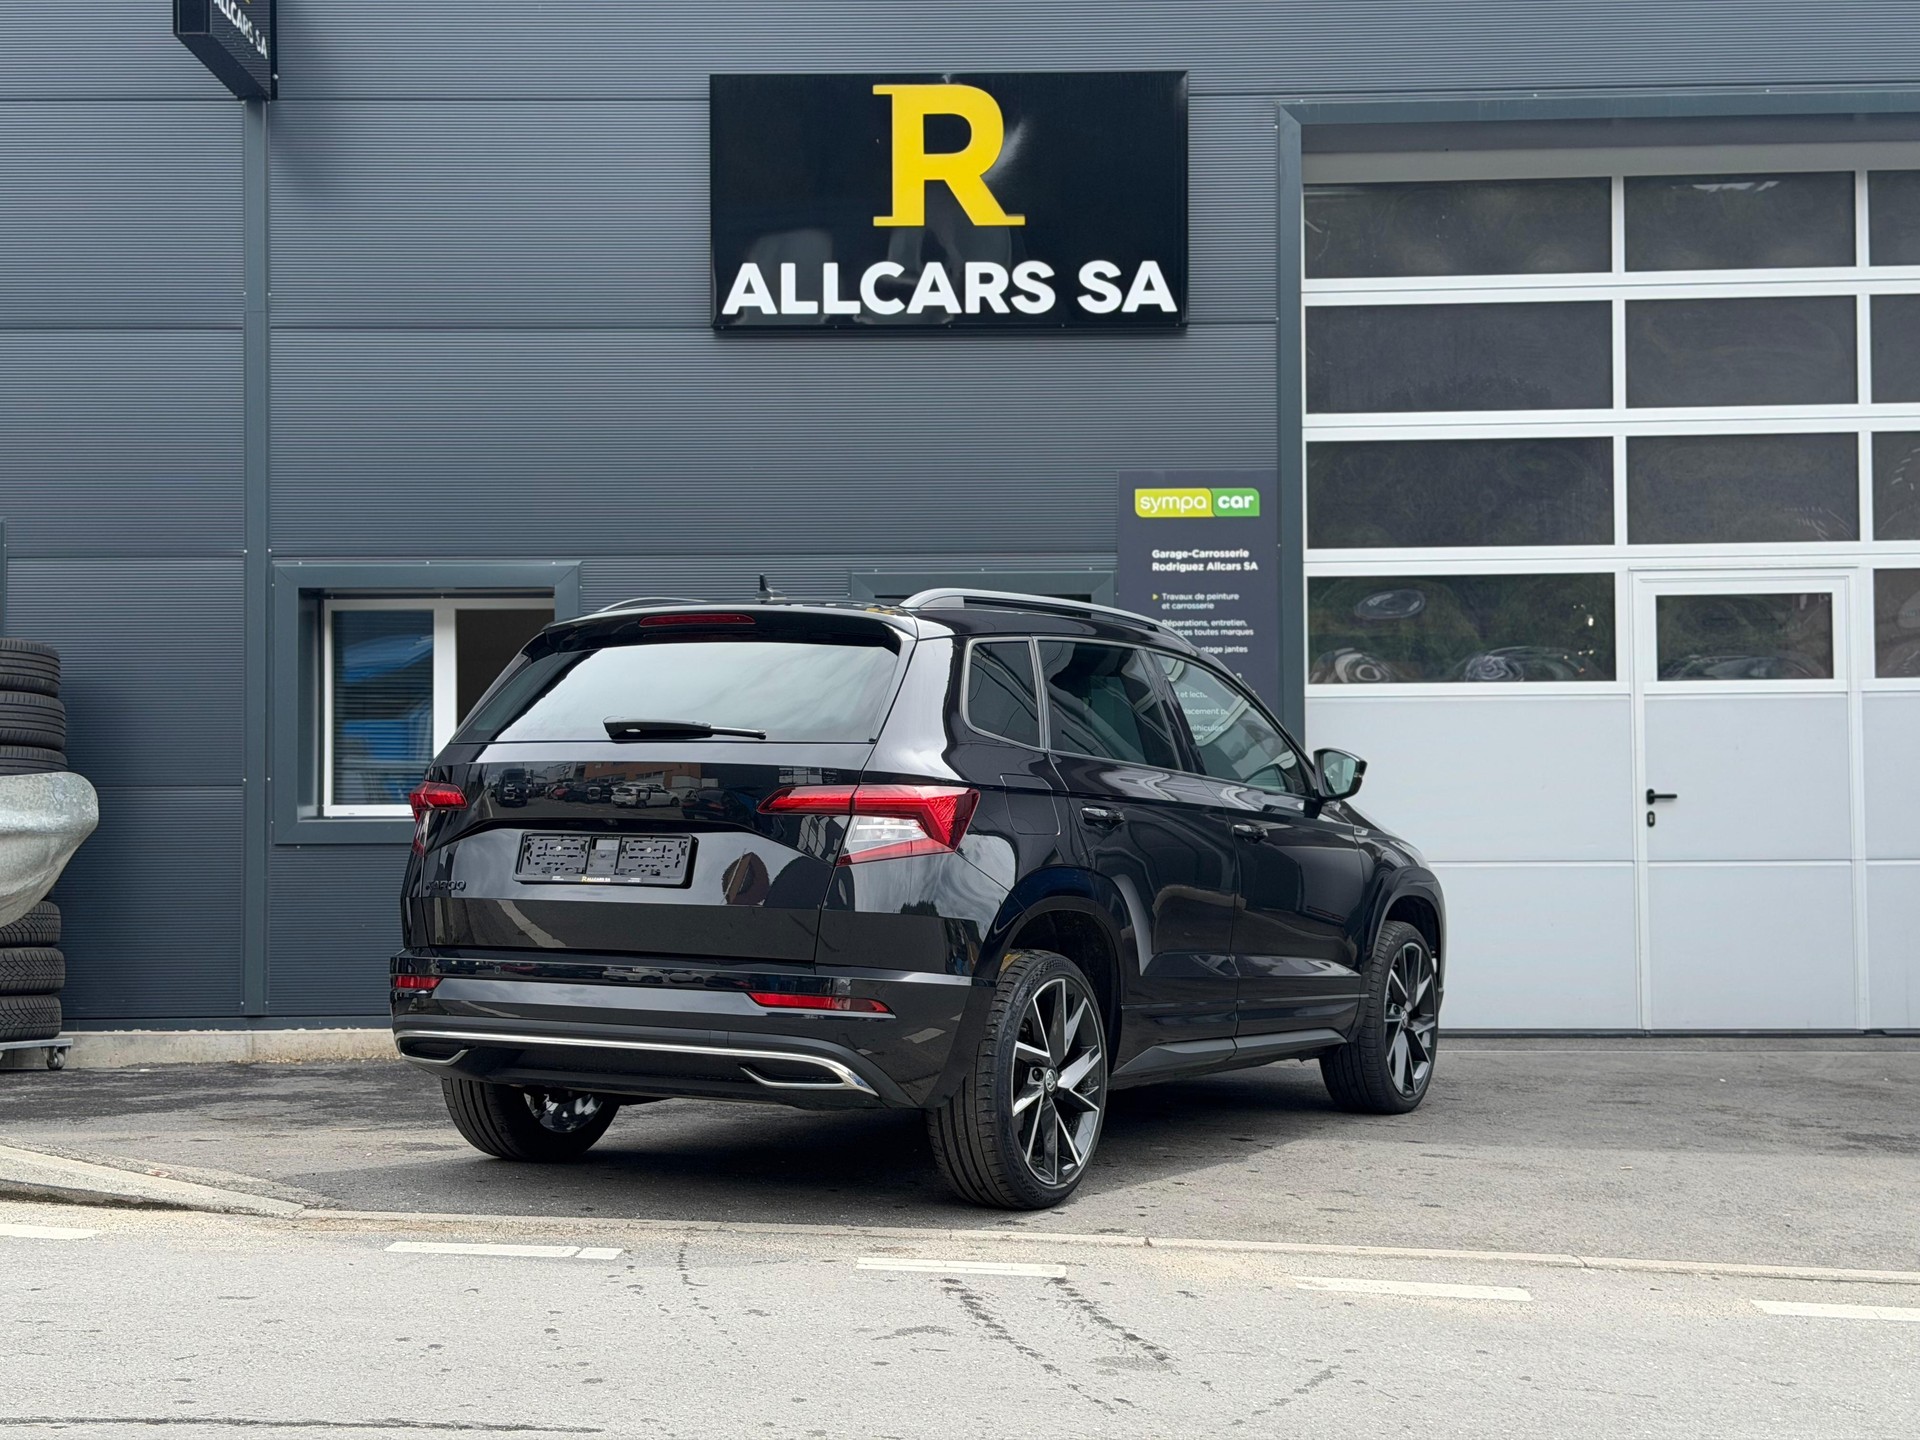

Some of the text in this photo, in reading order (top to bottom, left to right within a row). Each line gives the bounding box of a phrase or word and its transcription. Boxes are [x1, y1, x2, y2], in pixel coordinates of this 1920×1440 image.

[214, 0, 267, 59] LLCARS SA
[872, 84, 1026, 226] R
[721, 260, 1178, 315] ALLCARS SA
[1140, 495, 1254, 514] sympa car
[1151, 548, 1250, 560] Garage-Carrosserie
[1151, 561, 1258, 573] Rodriguez Allcars SA
[1161, 592, 1240, 602] Travaux de peinture
[1161, 602, 1214, 610] et carrosserie
[1210, 619, 1248, 627] entretien,
[1220, 629, 1254, 637] marques
[1224, 645, 1248, 654] jantes
